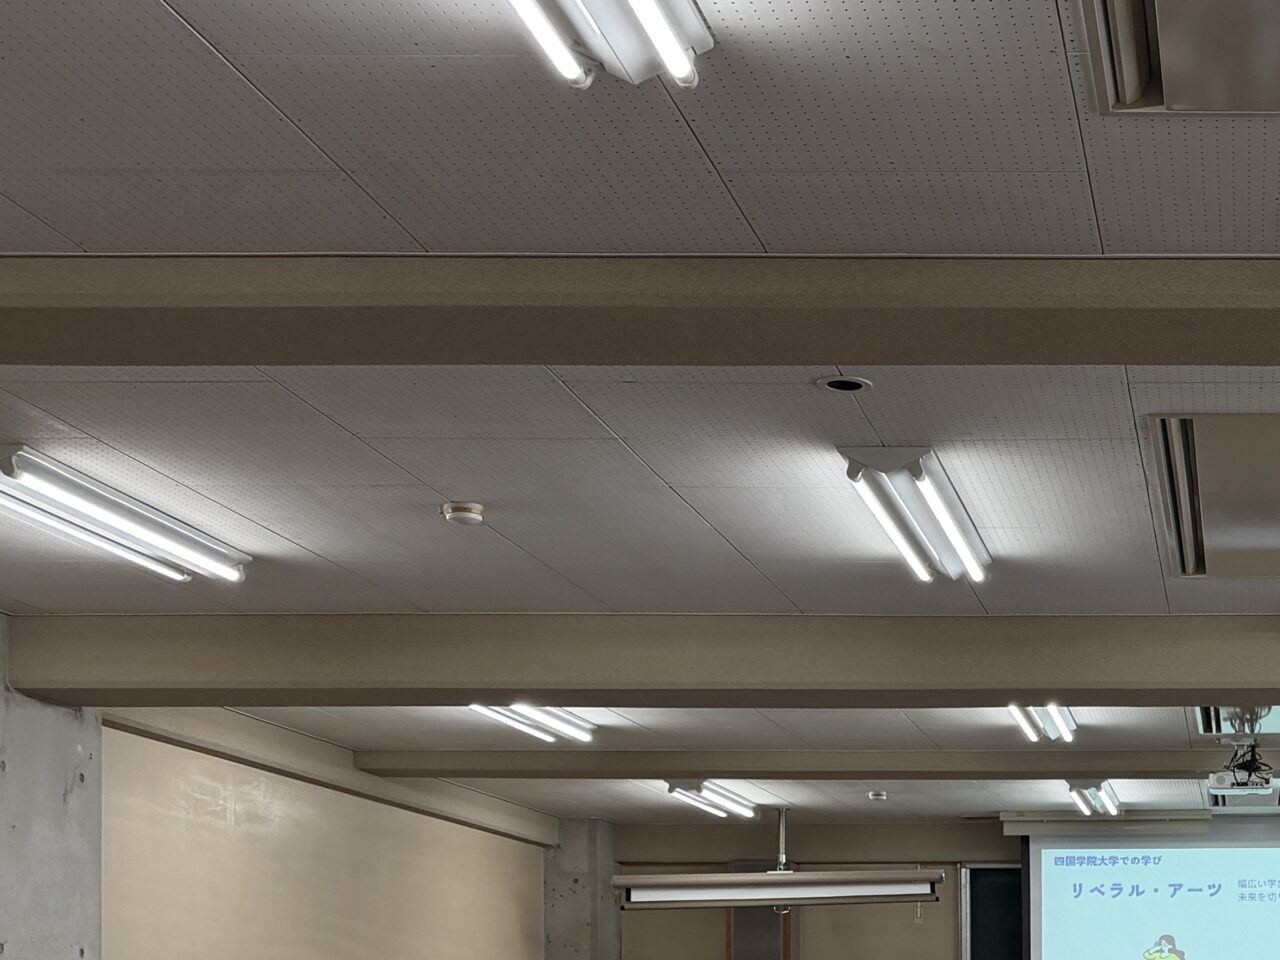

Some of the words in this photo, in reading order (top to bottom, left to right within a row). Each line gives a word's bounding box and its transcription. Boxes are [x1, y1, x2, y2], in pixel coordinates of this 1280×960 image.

[1053, 855, 1162, 867] 四国学院大学での学び
[1072, 882, 1222, 899] リベラル・アーツ
